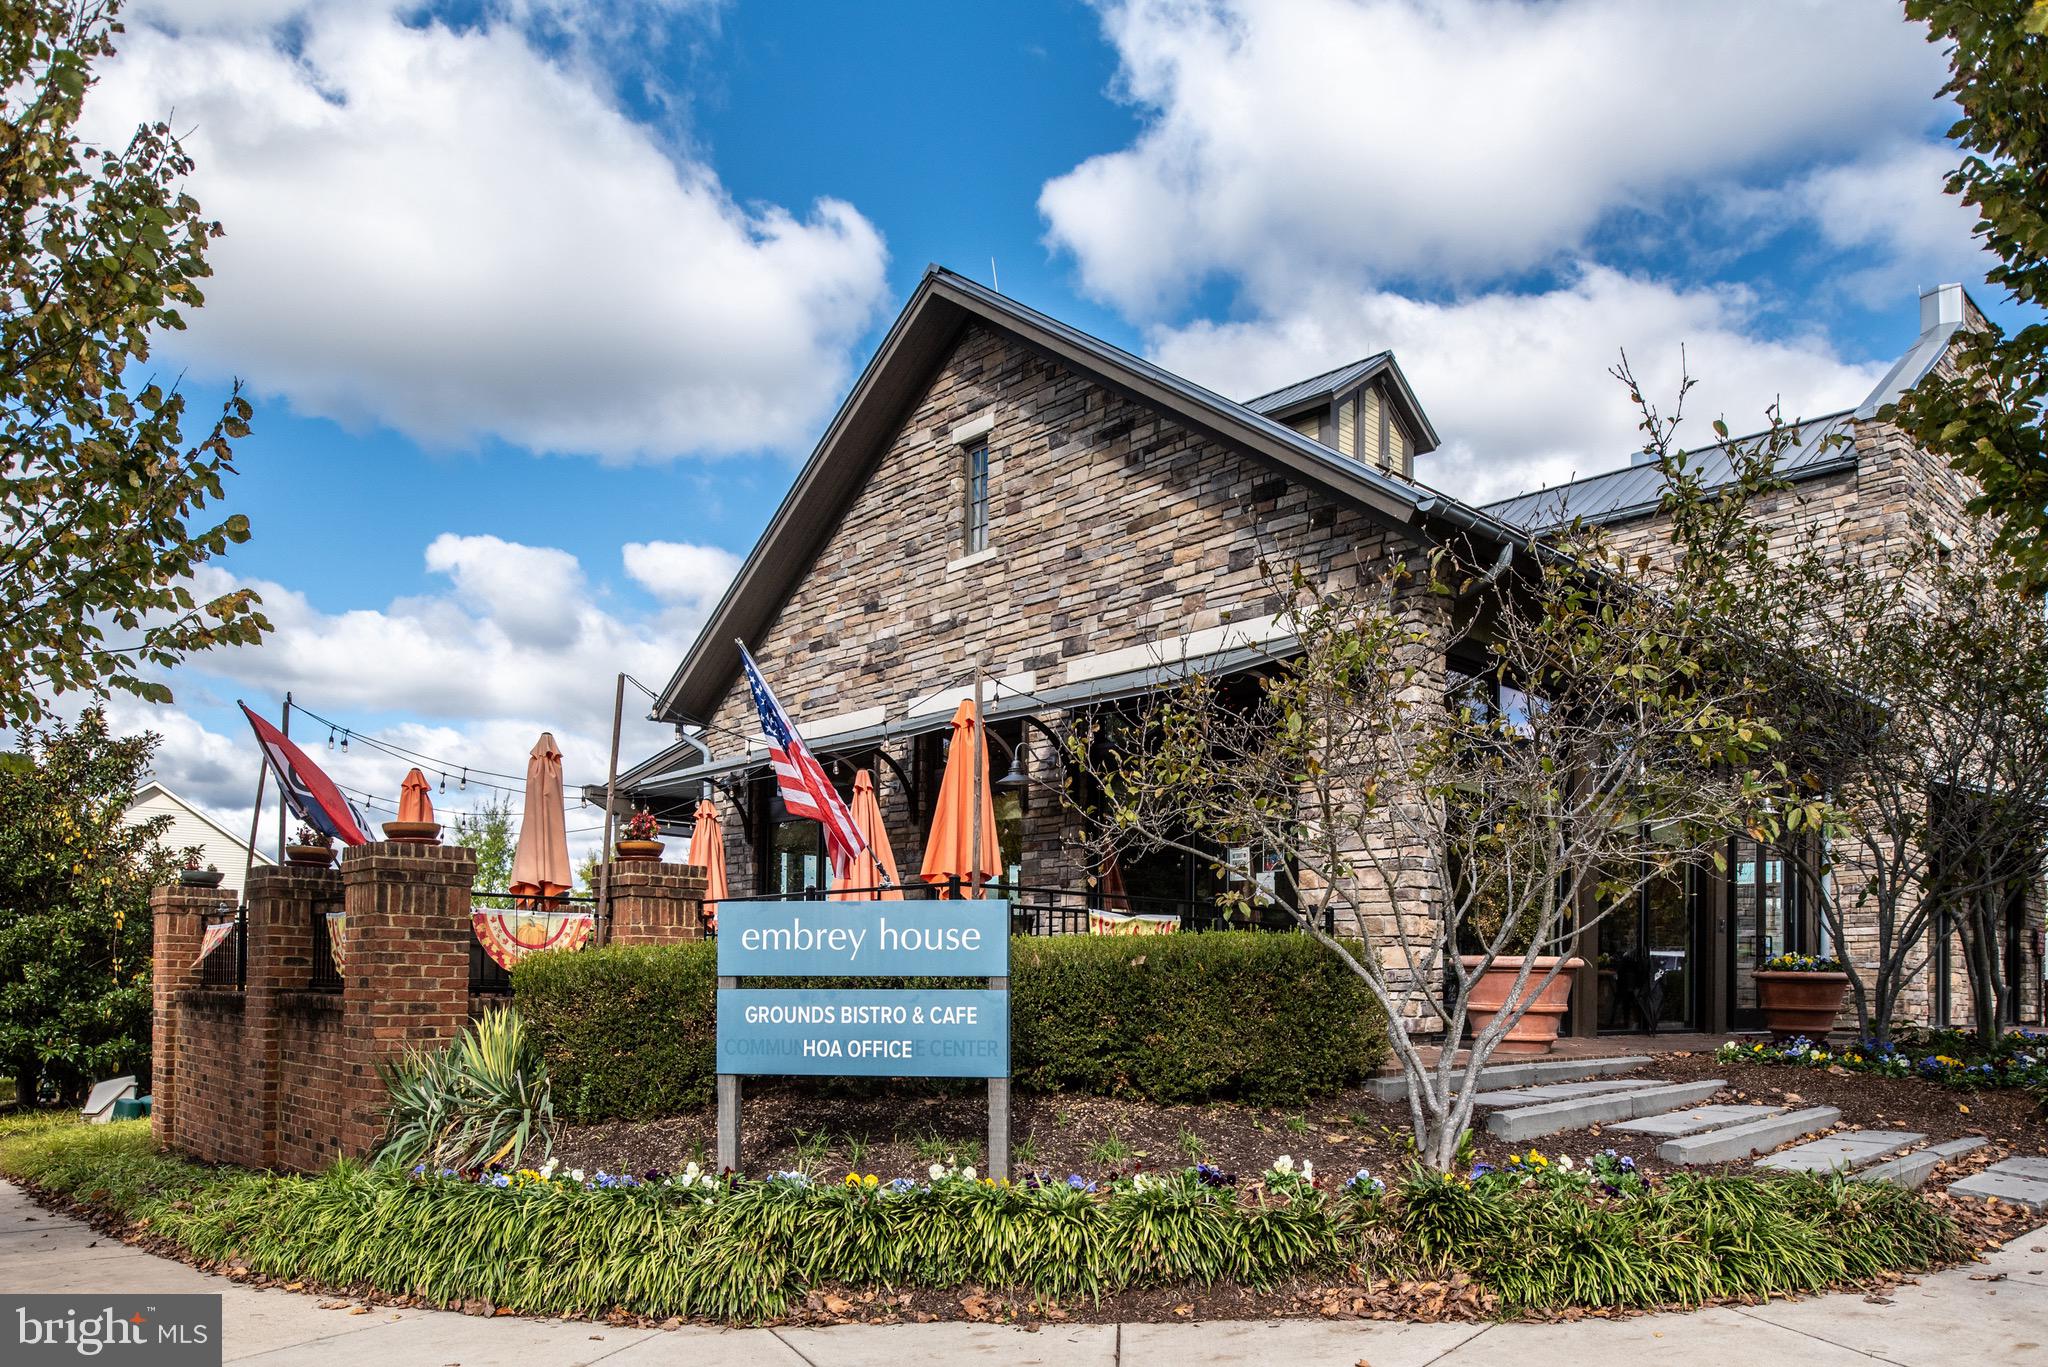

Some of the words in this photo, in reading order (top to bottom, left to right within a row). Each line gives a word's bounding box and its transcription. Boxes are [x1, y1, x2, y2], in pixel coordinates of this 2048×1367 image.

[741, 918, 866, 960] embrey
[880, 917, 981, 951] house
[745, 1005, 836, 1024] GROUNDS
[841, 1006, 907, 1024] BISTRO
[912, 1006, 925, 1024] &
[929, 1006, 978, 1025] CAFE
[724, 1038, 832, 1056] COMMUN
[930, 1040, 999, 1057] CENTER
[803, 1039, 843, 1057] HOA
[847, 1040, 912, 1058] OFFICE
